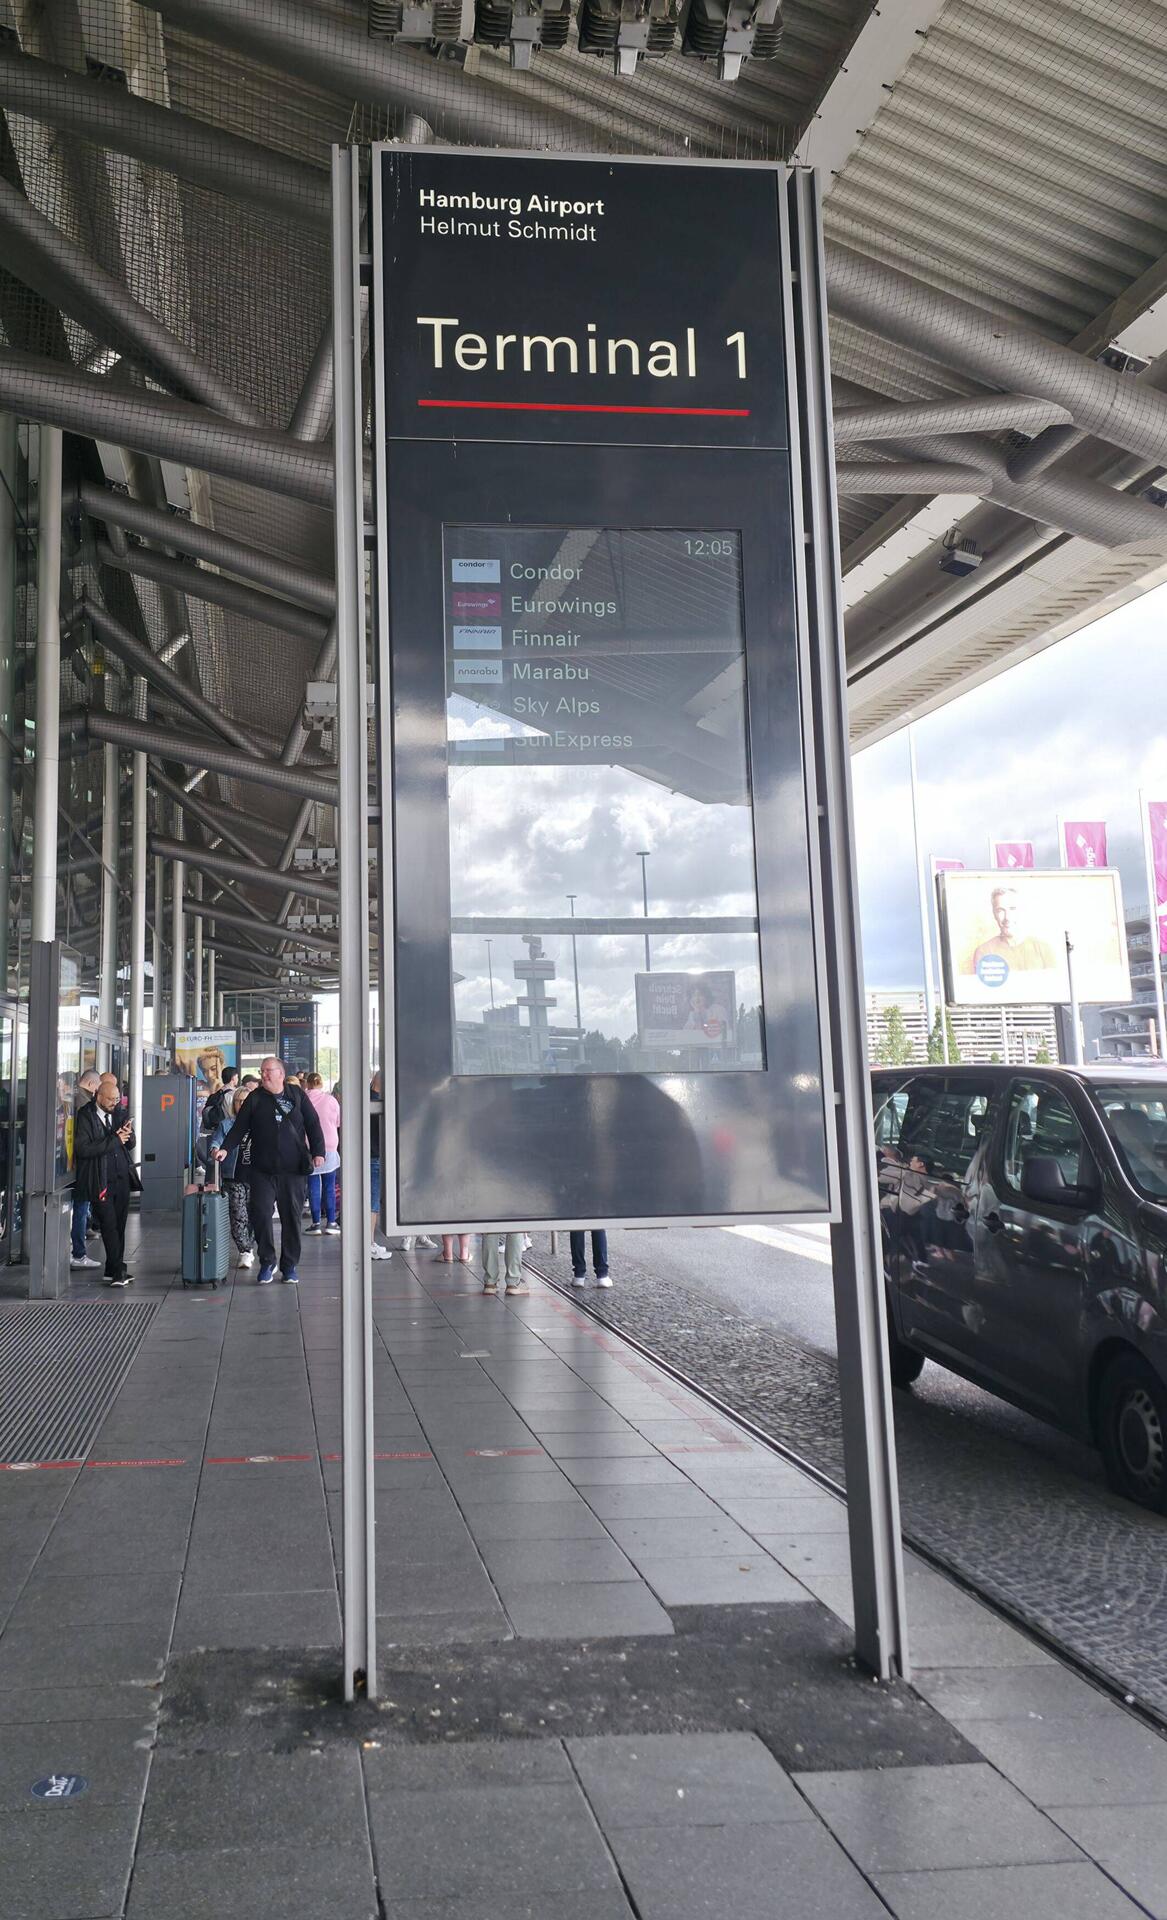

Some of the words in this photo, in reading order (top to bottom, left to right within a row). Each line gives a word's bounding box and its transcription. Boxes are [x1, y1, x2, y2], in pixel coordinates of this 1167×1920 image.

[419, 188, 522, 215] Hamburg
[527, 195, 605, 217] Airport
[420, 216, 501, 238] Helmut
[507, 219, 597, 242] Schmidt
[416, 316, 696, 378] Terminal
[726, 331, 747, 379] 1
[684, 540, 733, 555] 12:05
[510, 563, 584, 581] Condor
[510, 596, 617, 617] Eurowings
[511, 629, 581, 647] Finnair
[512, 662, 590, 681] Marabu
[513, 696, 549, 716] Sky
[556, 697, 601, 715] Alps
[514, 731, 633, 750] SunExpress
[160, 1094, 175, 1111] P
